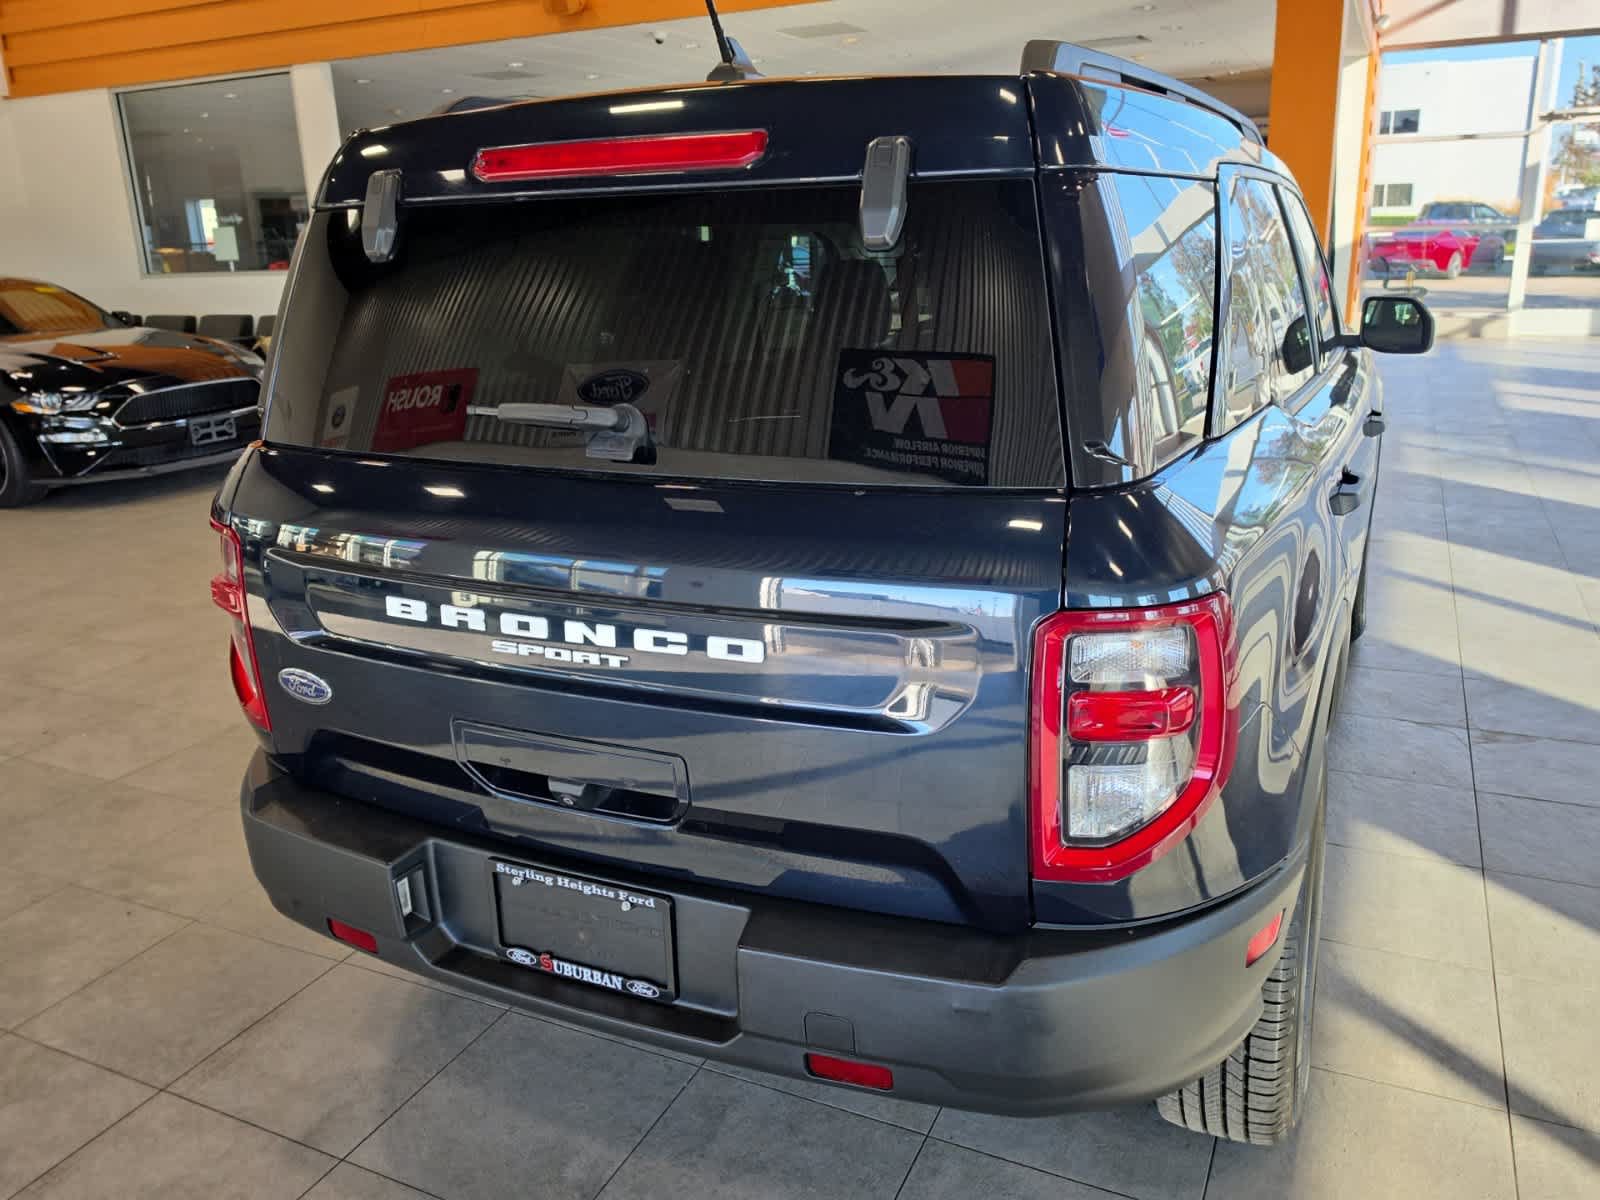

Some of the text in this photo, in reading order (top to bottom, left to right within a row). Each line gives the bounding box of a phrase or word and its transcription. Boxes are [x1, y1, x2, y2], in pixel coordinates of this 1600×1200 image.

[385, 594, 765, 664] BRONCO
[491, 640, 630, 668] SPORT
[496, 863, 655, 908] Sterling Heights Ford
[540, 953, 624, 991] SUBURBAN
